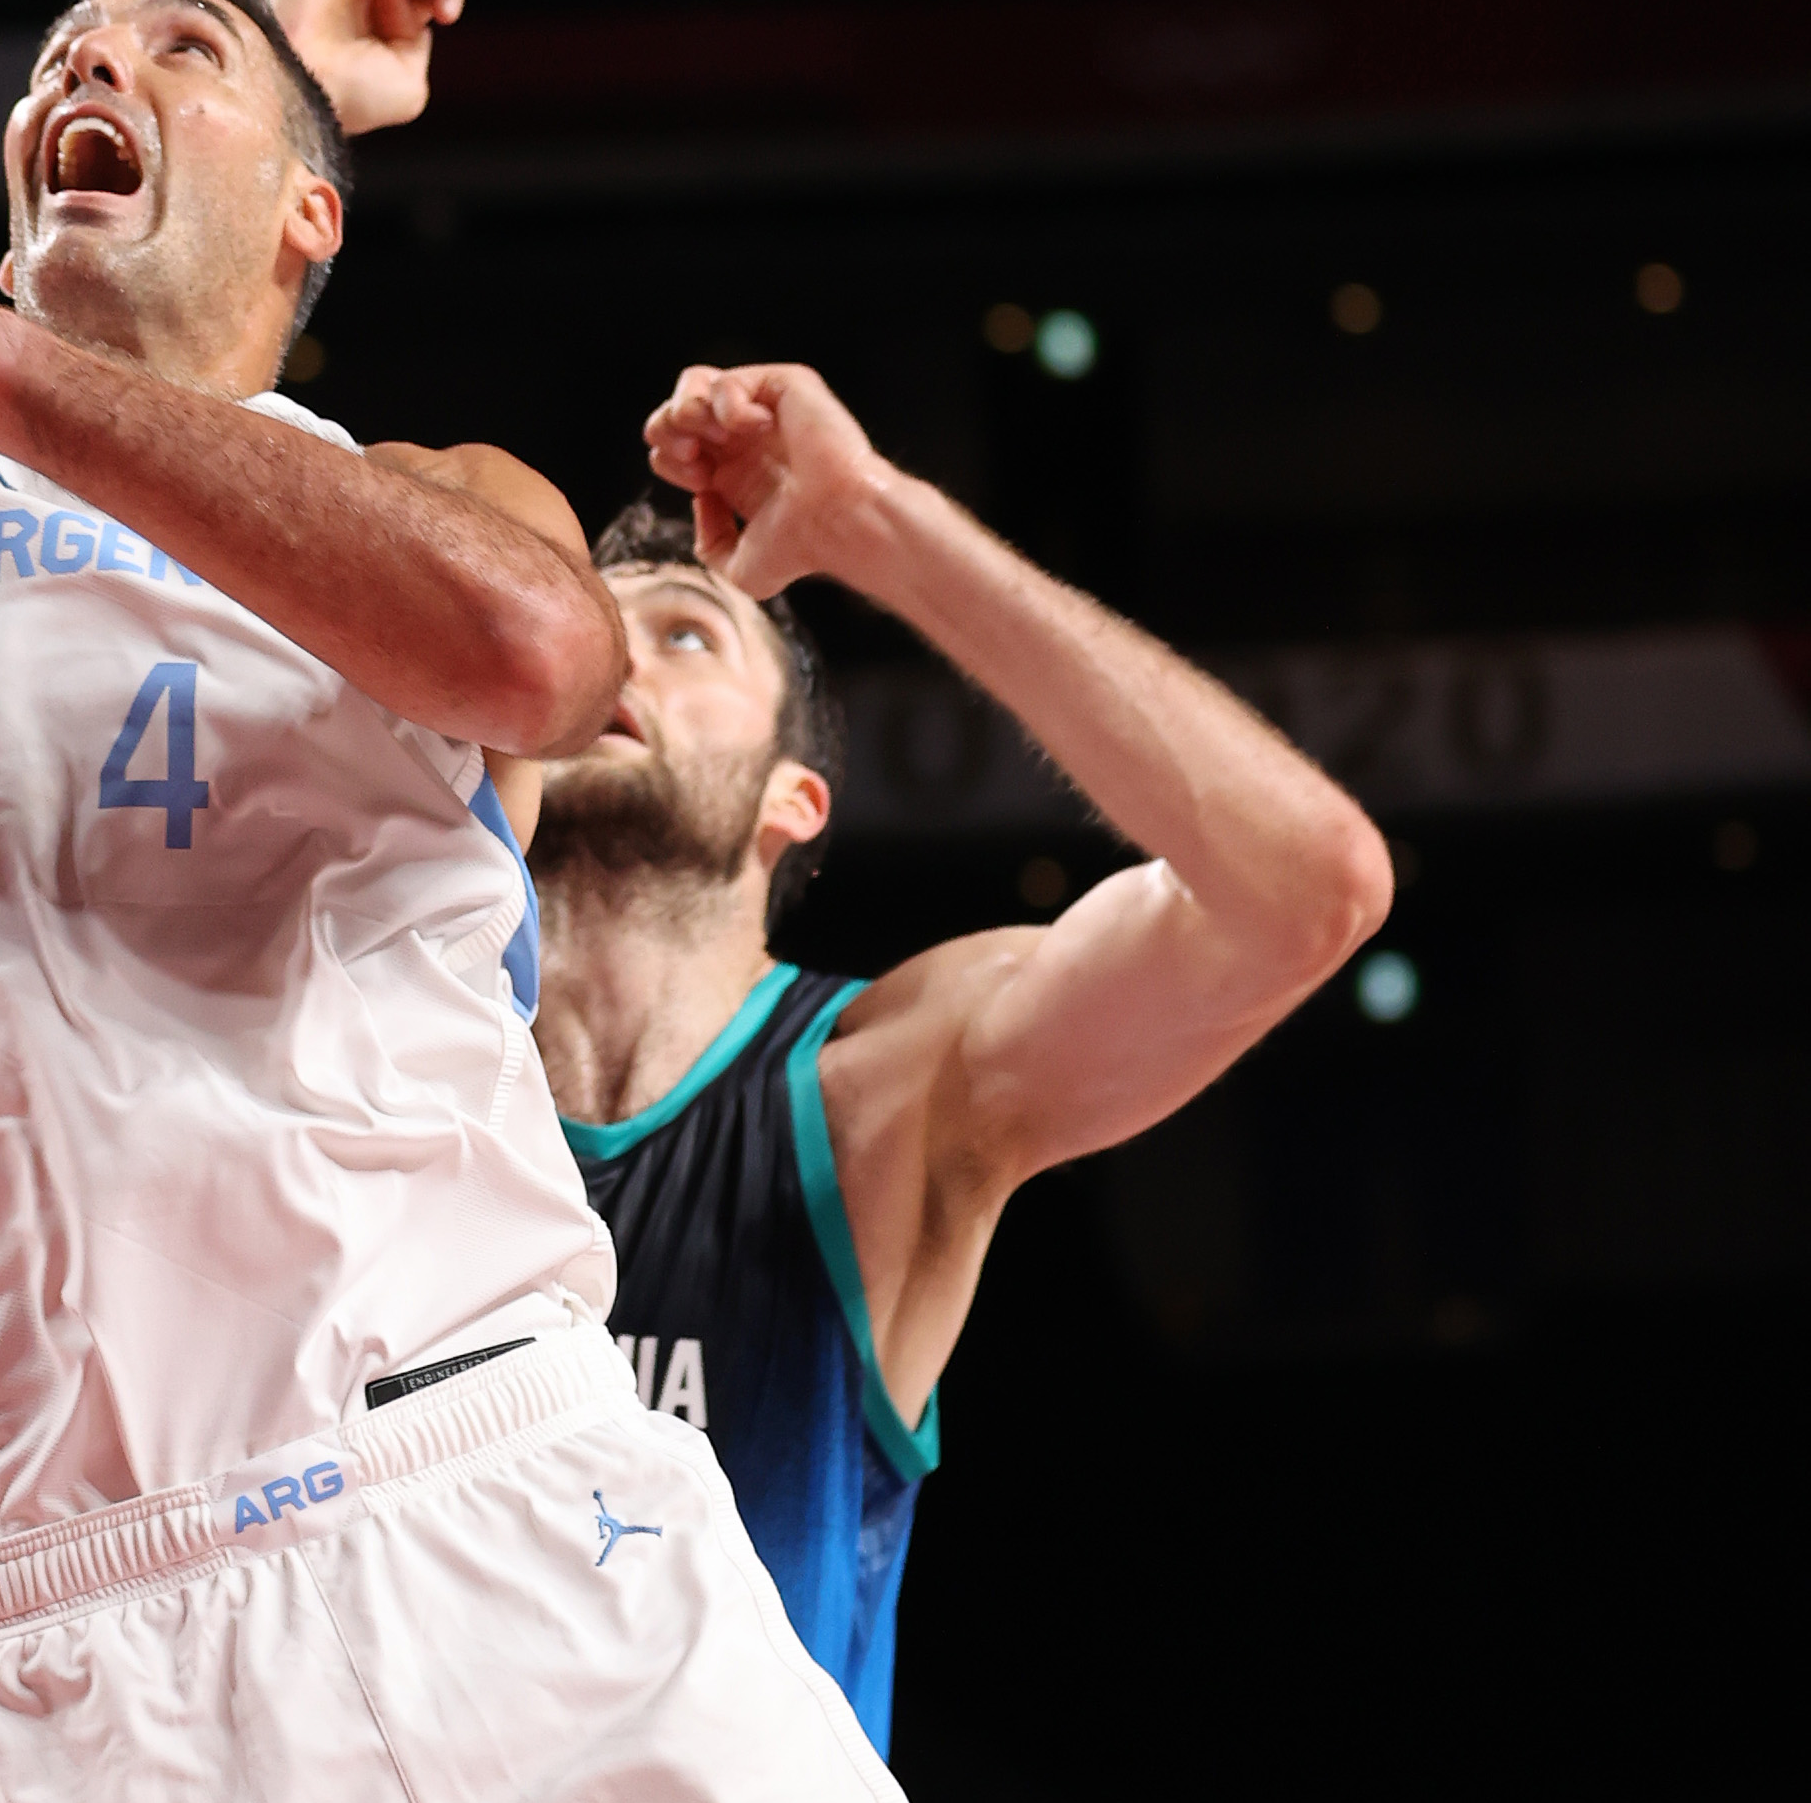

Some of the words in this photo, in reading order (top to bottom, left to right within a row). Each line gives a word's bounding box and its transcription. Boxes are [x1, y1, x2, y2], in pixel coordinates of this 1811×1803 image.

[98, 662, 209, 849] 4
[616, 1333, 709, 1429] IA
[235, 1460, 345, 1535] ARG
